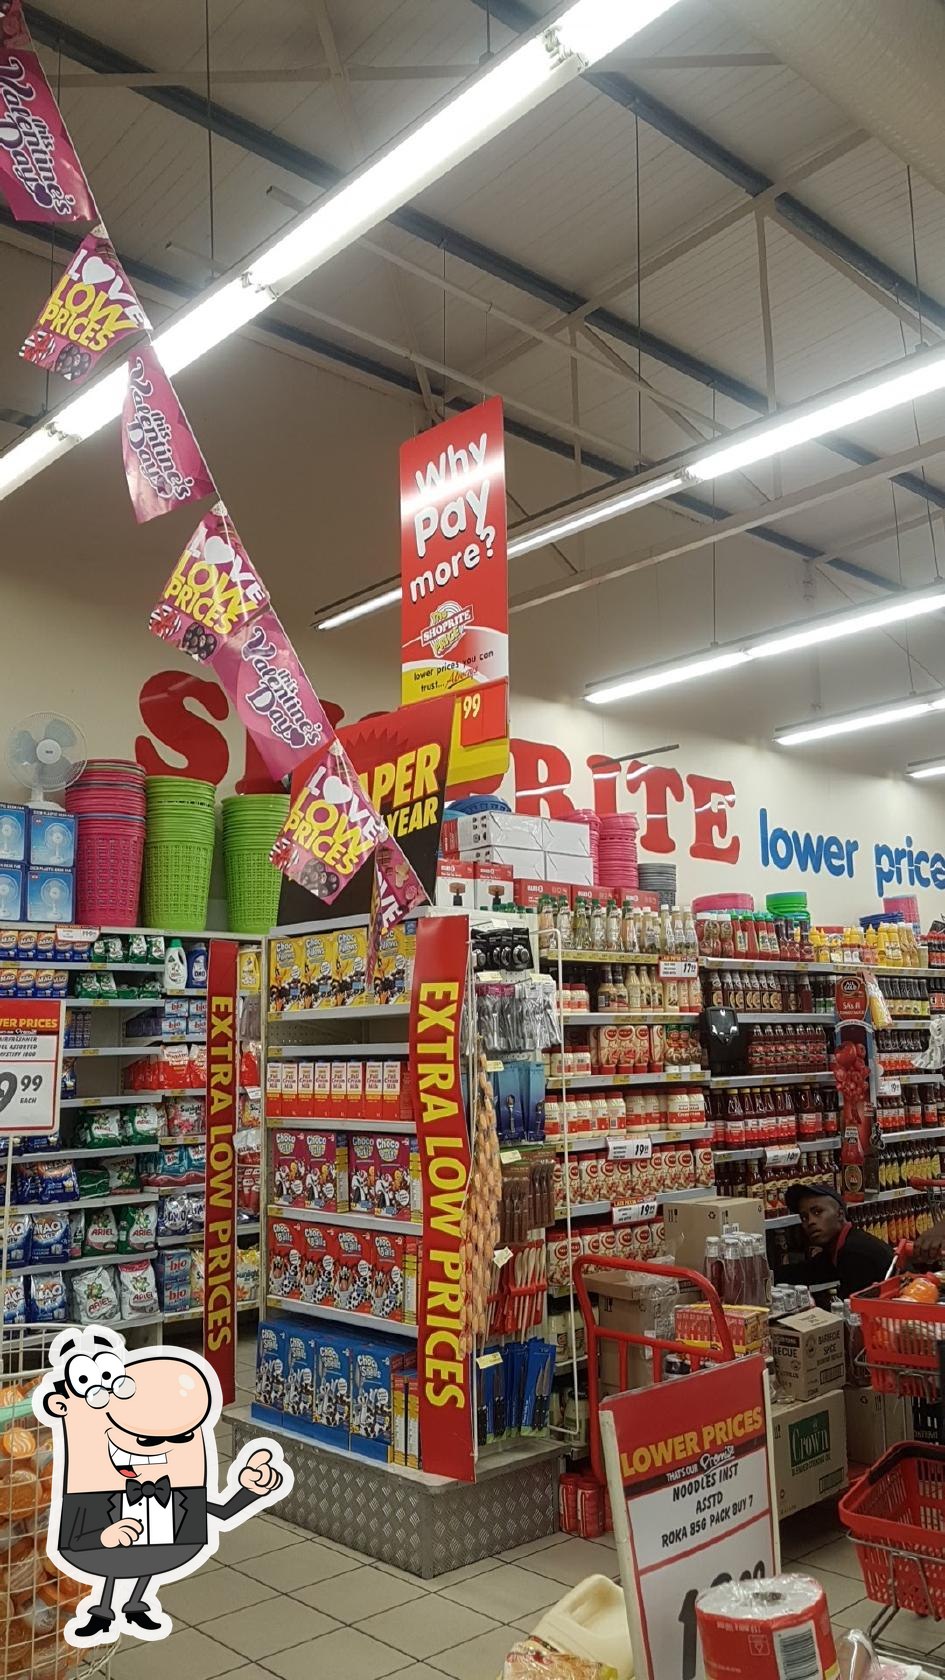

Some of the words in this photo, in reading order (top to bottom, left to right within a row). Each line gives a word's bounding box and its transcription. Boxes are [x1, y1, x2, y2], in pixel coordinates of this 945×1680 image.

[39, 303, 115, 351] PRICES
[48, 274, 139, 332] LOW
[150, 410, 171, 440] this
[415, 433, 488, 494] Why
[414, 480, 490, 557] Pay
[173, 549, 258, 620] LOW
[410, 525, 496, 603] more?
[164, 576, 239, 634] PRICES
[423, 608, 471, 641] SHOPRITE
[277, 668, 298, 694] this
[414, 668, 434, 680] lower
[437, 661, 459, 676] prices
[462, 655, 476, 667] you
[479, 650, 494, 661] can
[463, 693, 480, 719] 99
[283, 813, 360, 875] PRICES
[290, 787, 375, 855] LOW
[760, 807, 859, 878] lower
[19, 1018, 58, 1028] PRICES
[210, 996, 232, 1115] EXTRA
[417, 982, 459, 1123] EXTRA
[21, 1074, 43, 1092] 99
[276, 1133, 295, 1143] Choco
[307, 1135, 326, 1145] Choco
[377, 1138, 399, 1149] Choco
[207, 1124, 233, 1207] LOW
[425, 1137, 469, 1239] LOW
[133, 1229, 152, 1237] ARIEL
[88, 1298, 112, 1312] ARIEL
[208, 1221, 232, 1351] PRICES
[425, 1249, 466, 1409] PRICES
[824, 1343, 837, 1355] SPICE
[620, 1430, 700, 1477] LOWER
[702, 1406, 763, 1448] PRICES
[666, 1469, 686, 1482] THAT'S
[686, 1463, 698, 1475] OUR
[700, 1445, 735, 1469] Promise
[793, 1428, 829, 1462] Crown
[672, 1473, 716, 1502] NOODLES
[719, 1462, 739, 1483] INST
[661, 1525, 687, 1548] ROKA
[690, 1517, 706, 1536] 85G
[710, 1505, 731, 1526] PACK
[732, 1495, 747, 1515] BUY
[748, 1494, 754, 1508] 7
